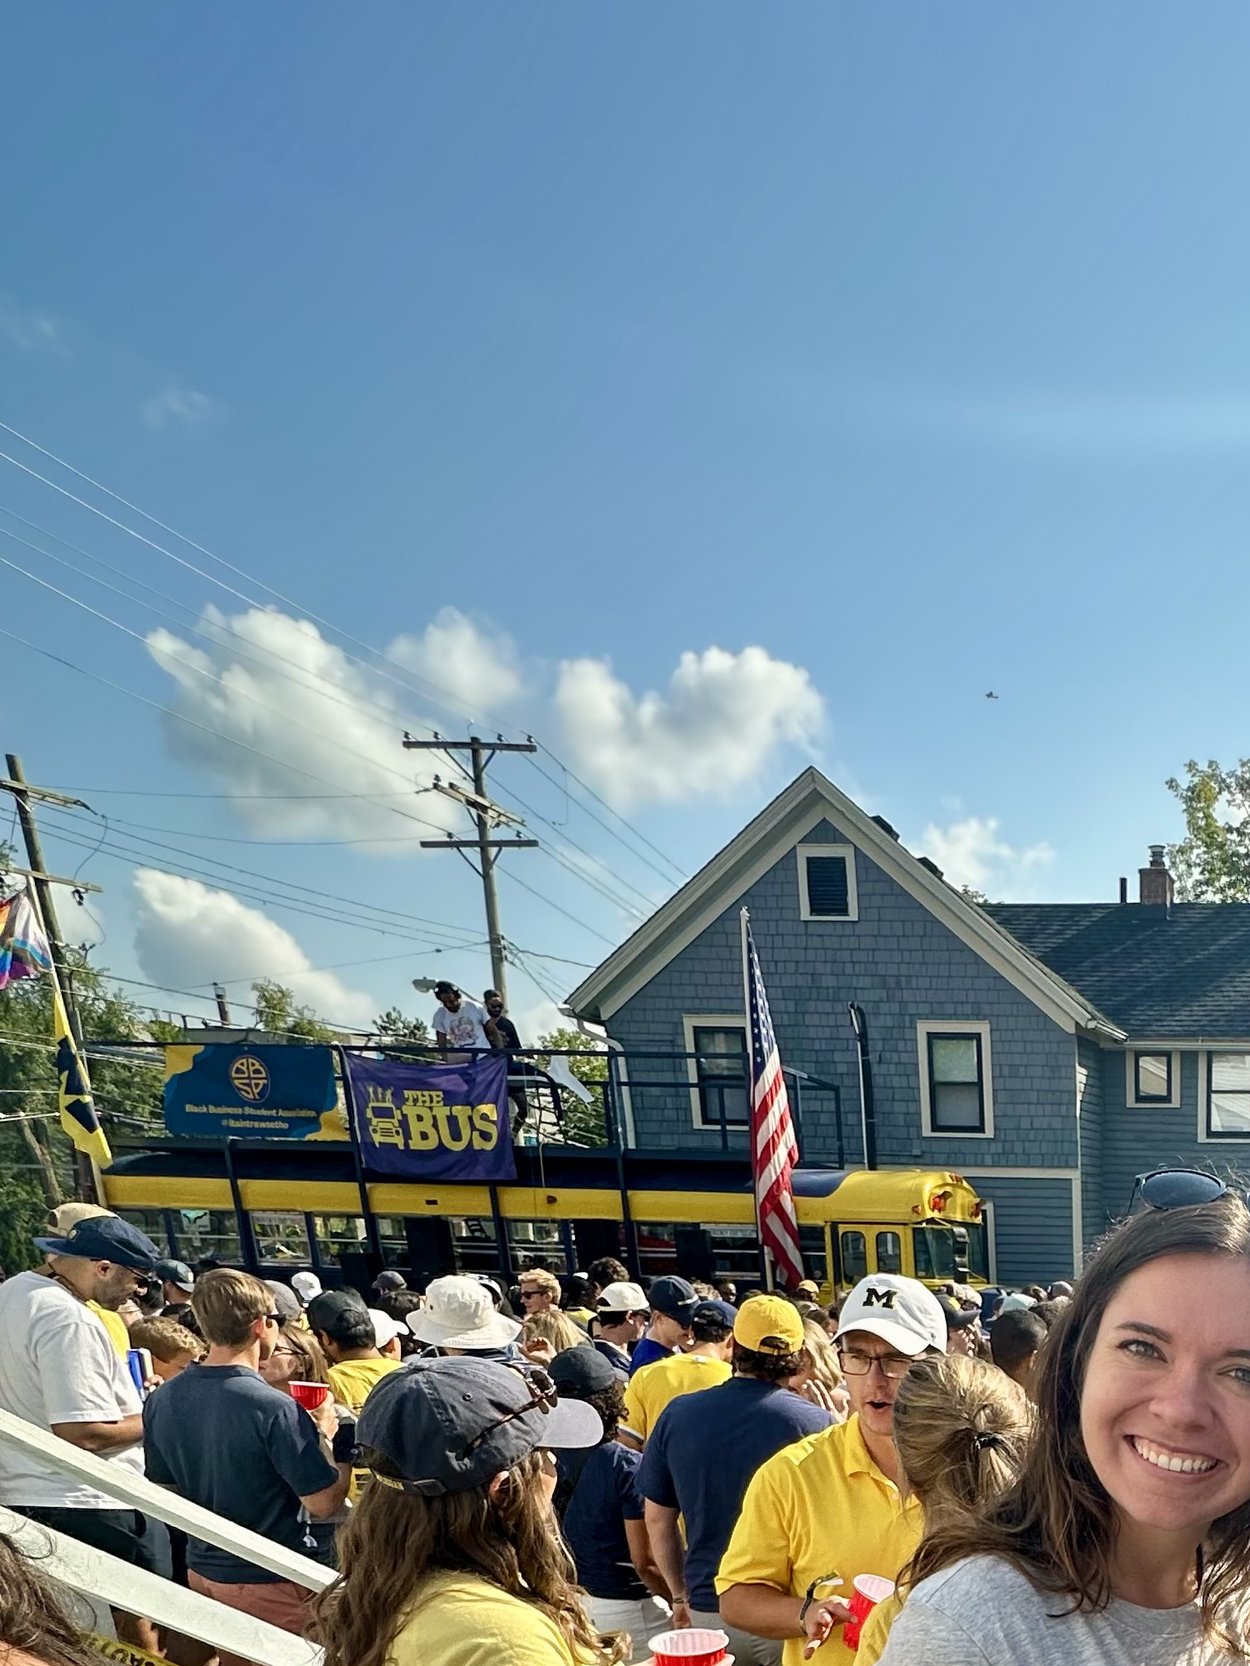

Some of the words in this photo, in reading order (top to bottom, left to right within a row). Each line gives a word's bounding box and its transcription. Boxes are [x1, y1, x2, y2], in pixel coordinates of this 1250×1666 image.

[403, 1089, 444, 1107] THE
[185, 1103, 208, 1113] Black
[243, 1105, 278, 1116] Student
[402, 1103, 498, 1152] BUS
[863, 1287, 897, 1309] M
